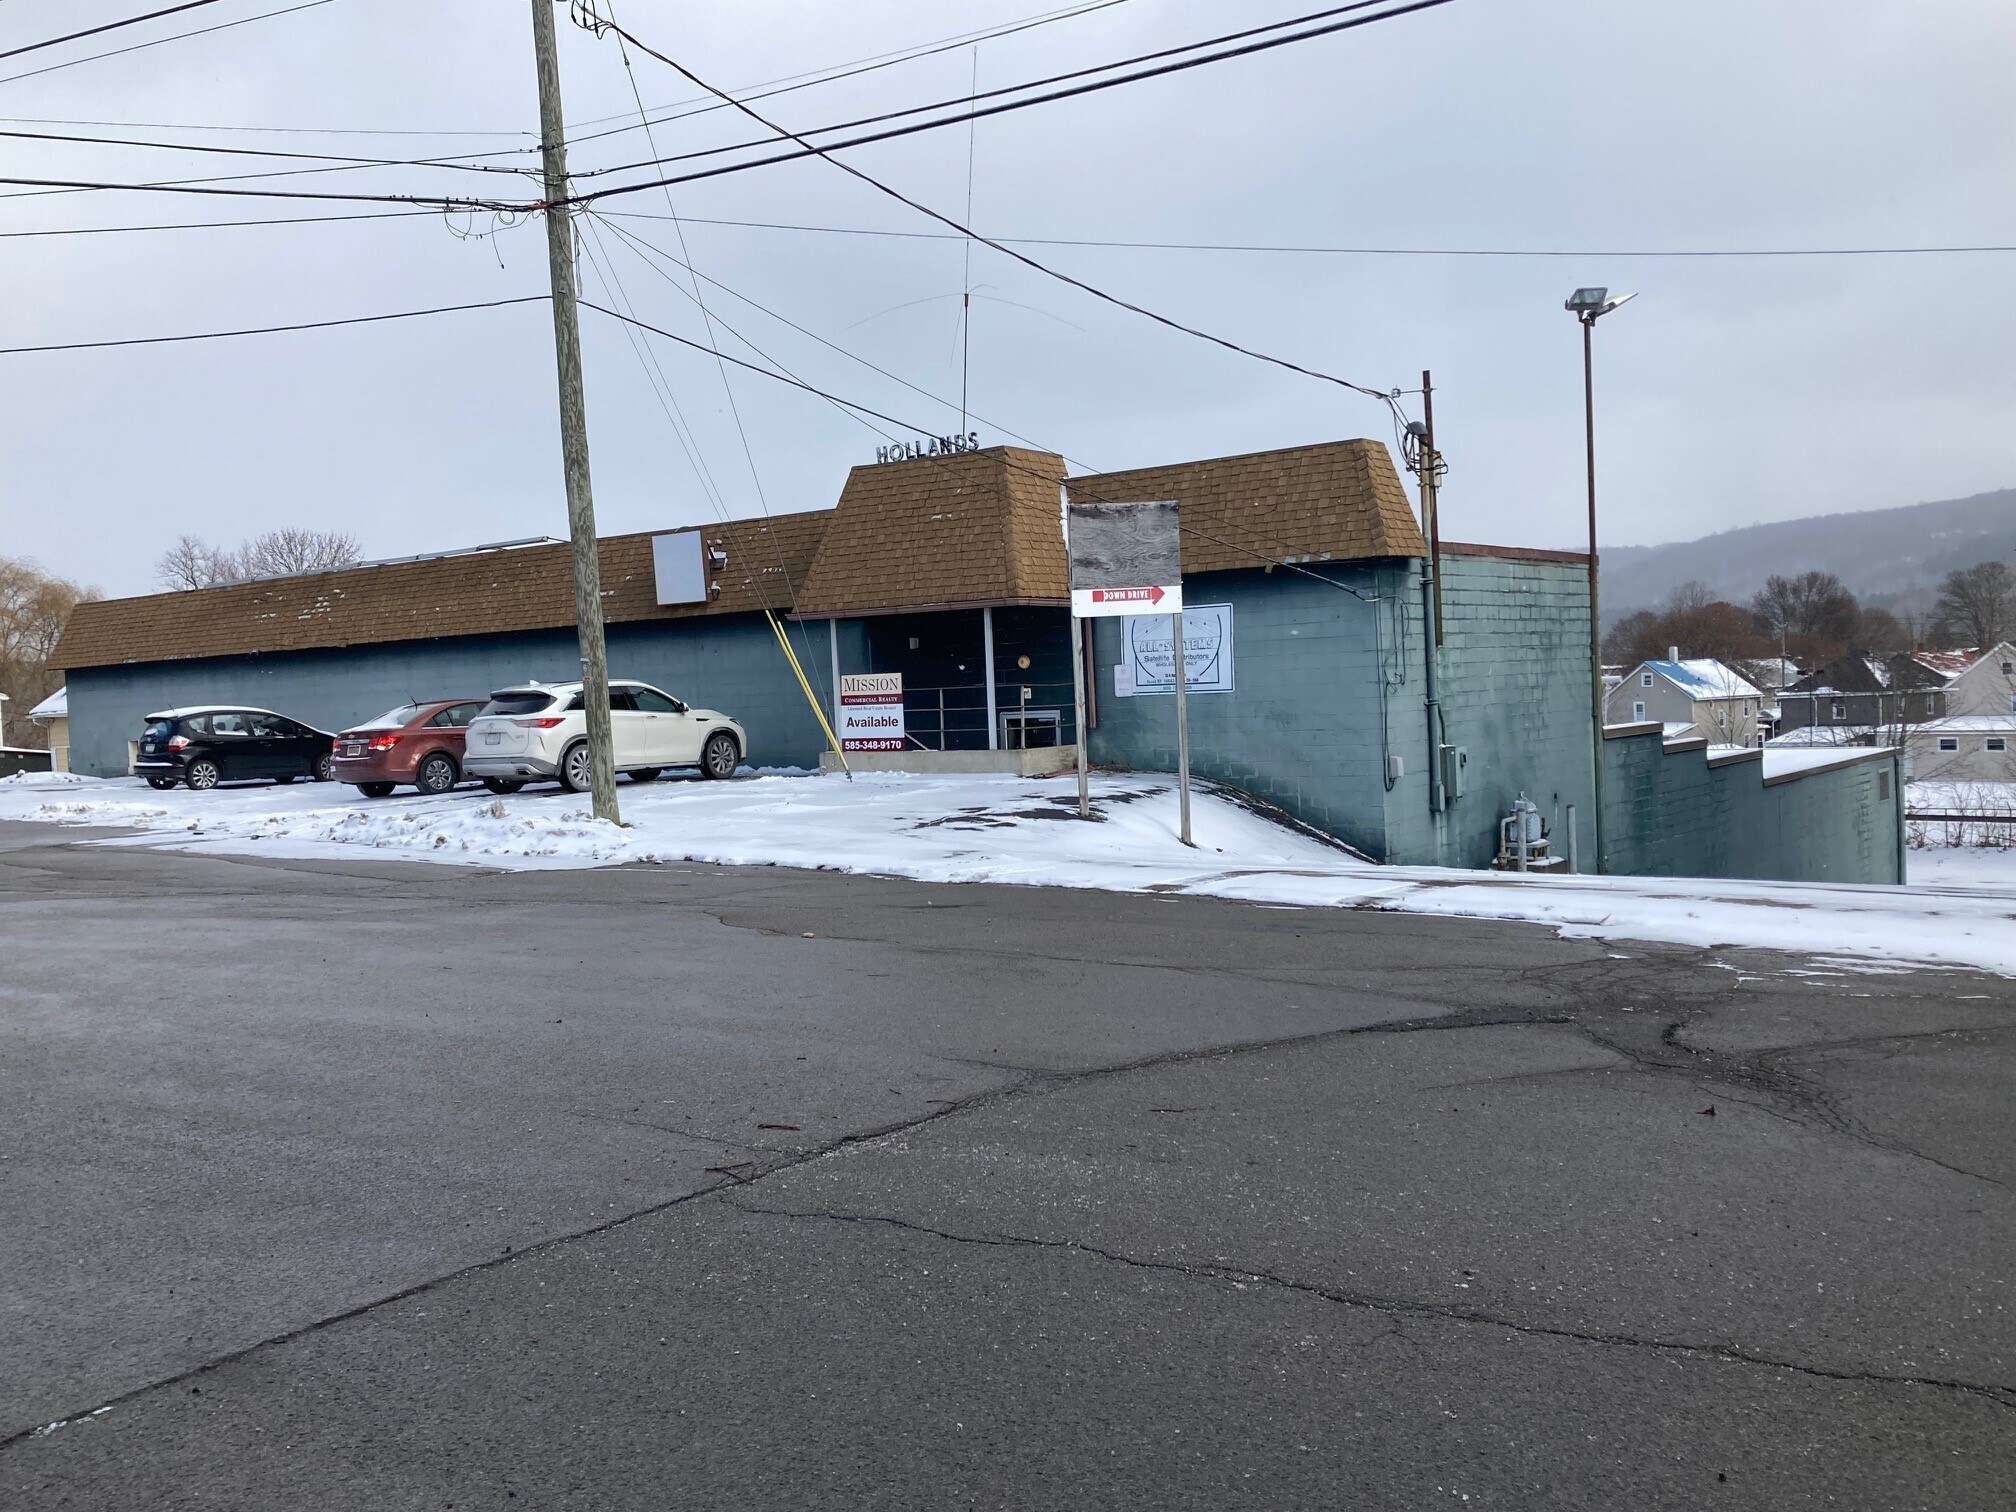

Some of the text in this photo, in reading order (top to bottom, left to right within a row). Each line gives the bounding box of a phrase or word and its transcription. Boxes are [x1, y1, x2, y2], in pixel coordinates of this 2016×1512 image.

[876, 432, 979, 464] HOLLANDS
[1104, 590, 1148, 600] DOWN DRIVE
[846, 716, 898, 727] Available
[845, 741, 901, 749] 585-348-9170
